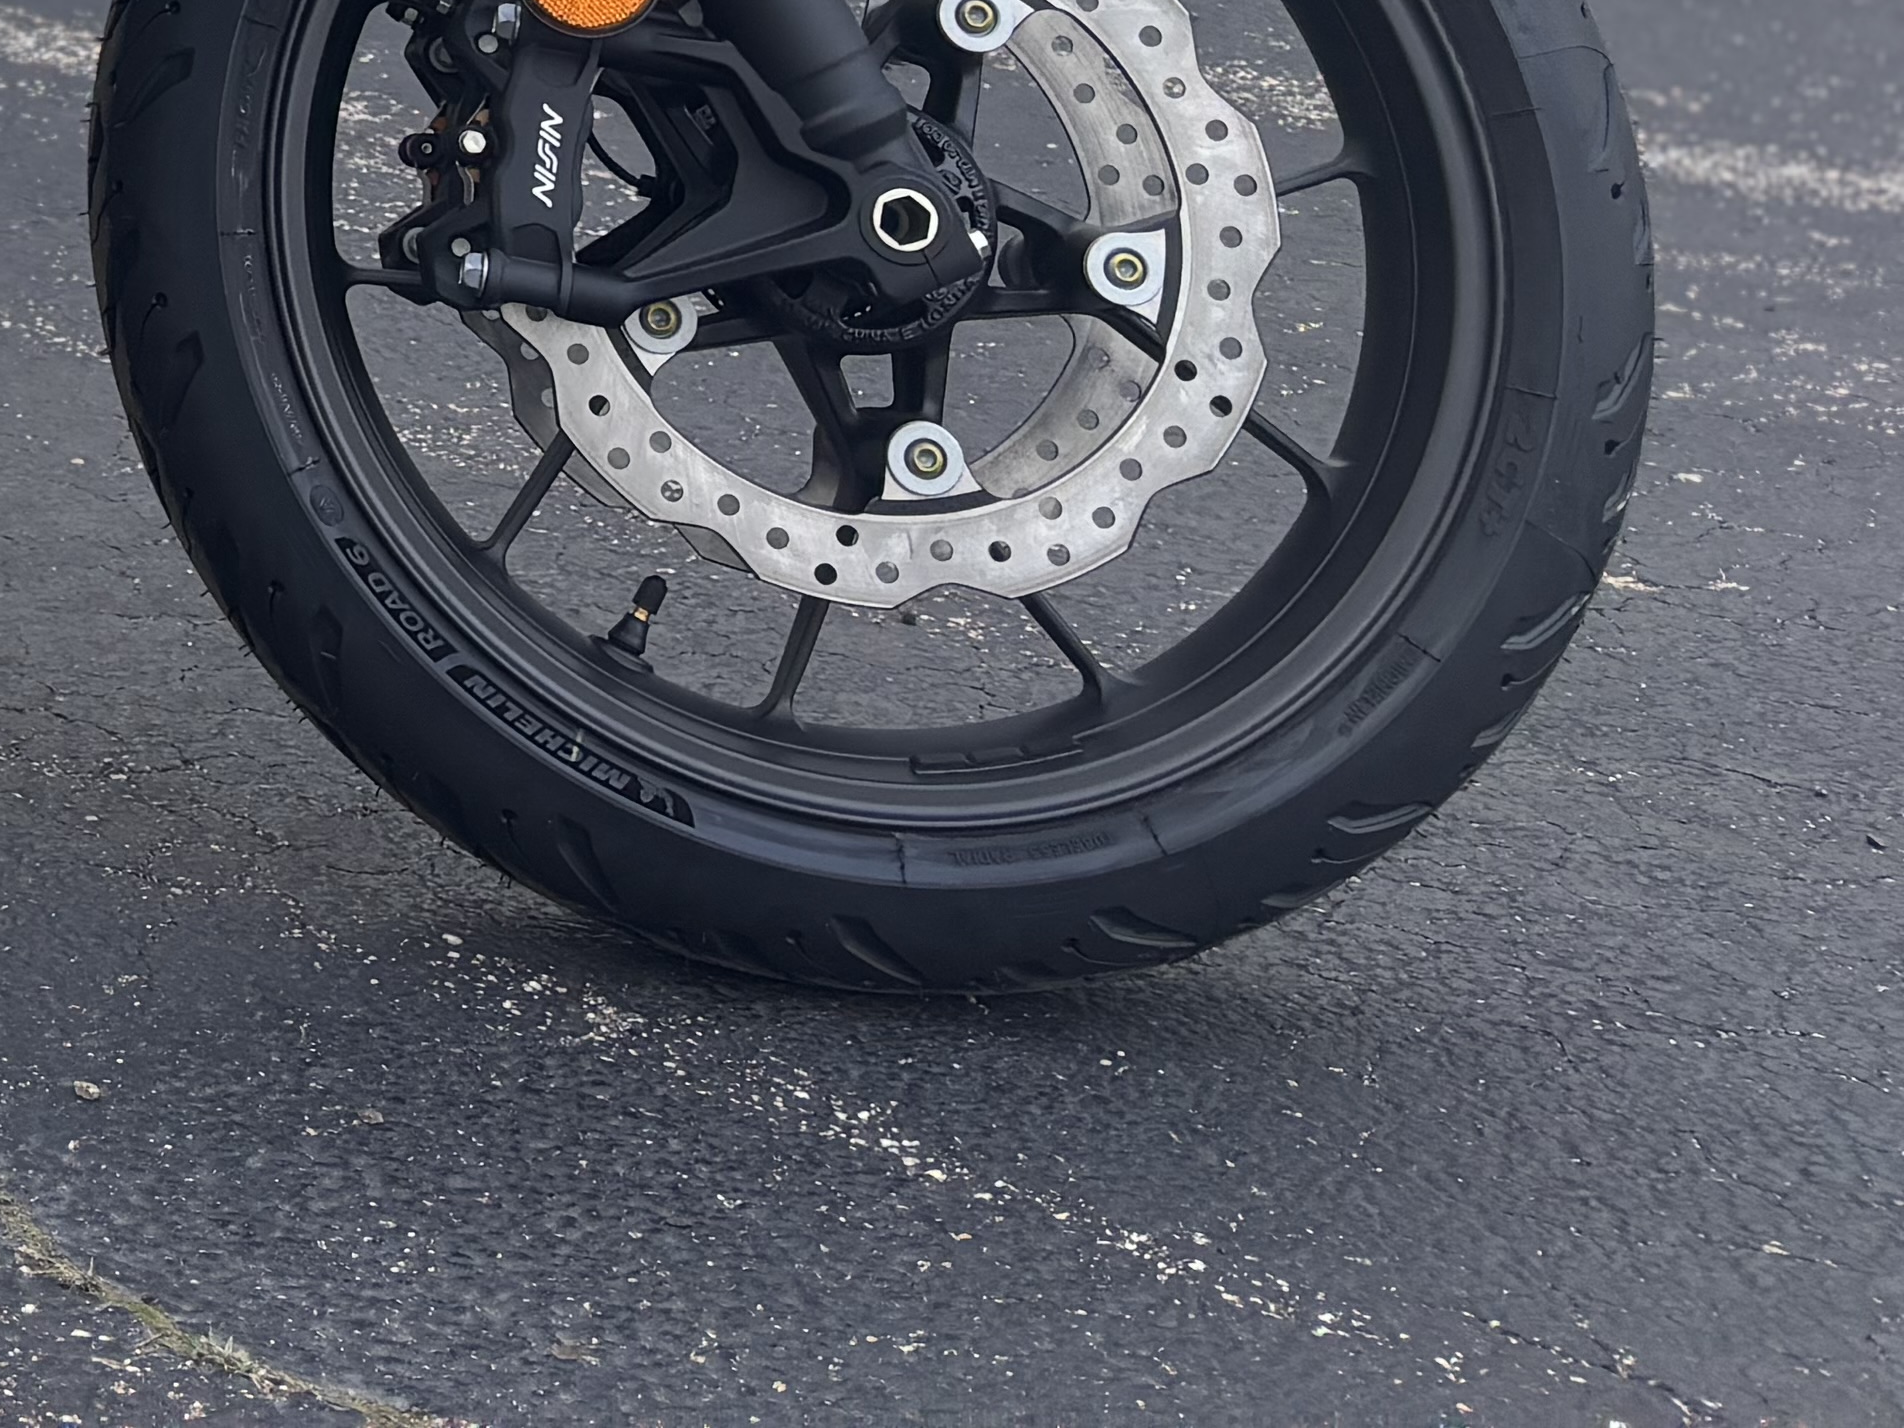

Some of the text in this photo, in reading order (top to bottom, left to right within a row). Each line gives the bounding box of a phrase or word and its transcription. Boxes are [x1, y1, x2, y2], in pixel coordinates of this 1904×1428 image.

[345, 544, 446, 652] ROAD 6
[463, 673, 632, 792] MICHELIN
